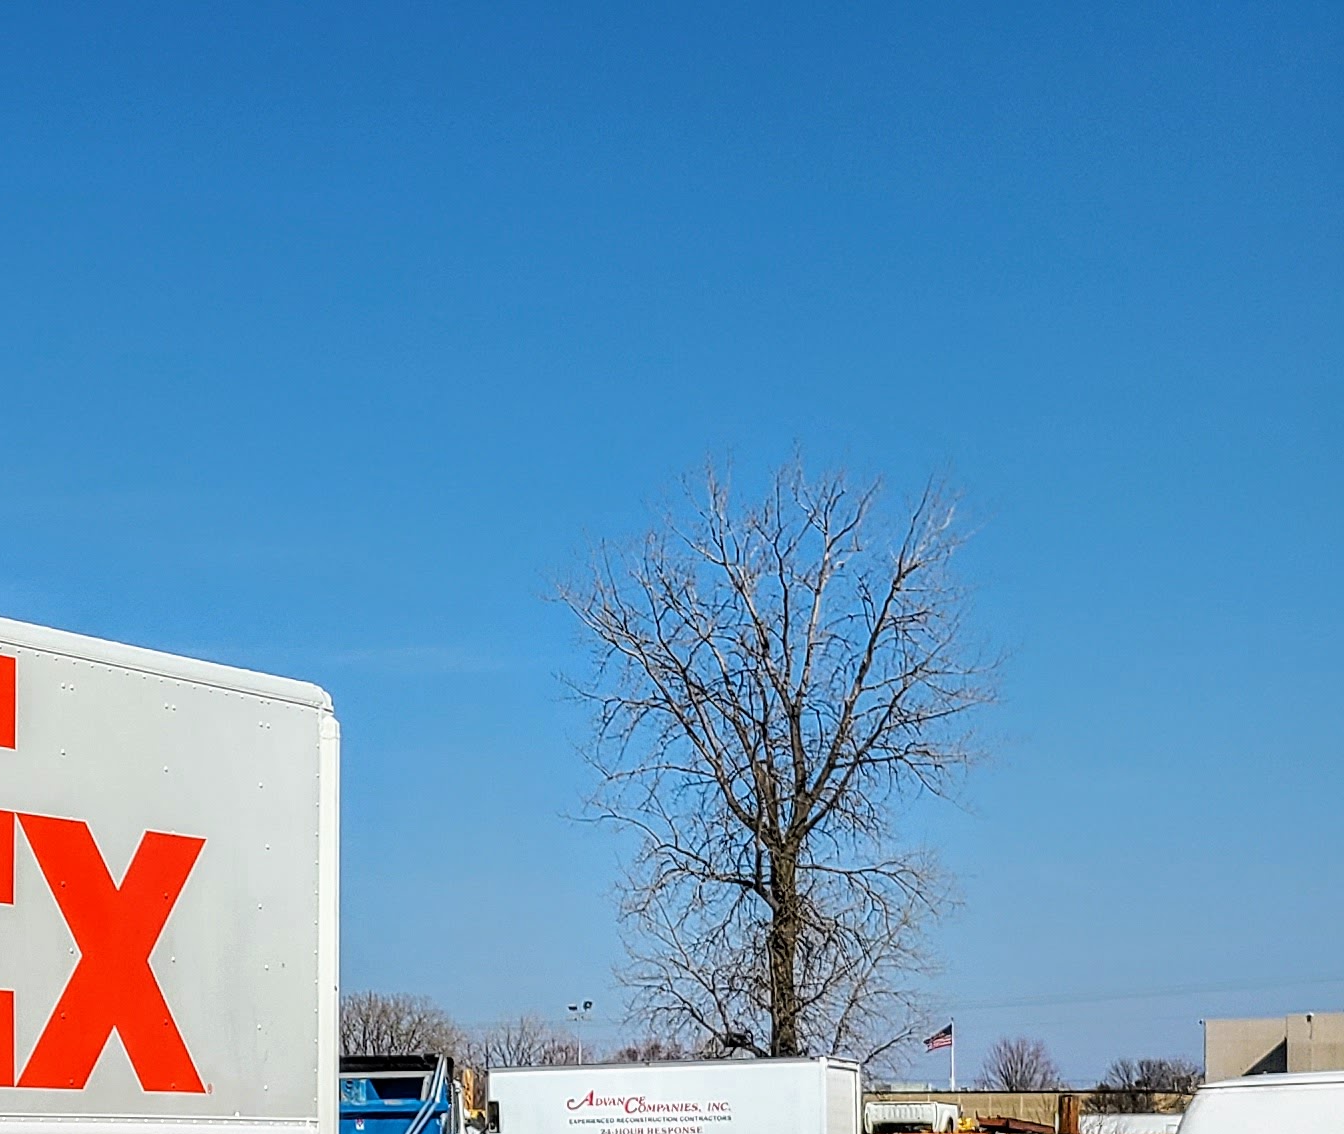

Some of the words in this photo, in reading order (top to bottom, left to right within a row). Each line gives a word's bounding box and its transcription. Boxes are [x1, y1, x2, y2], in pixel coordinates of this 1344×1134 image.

[707, 1102, 731, 1112] INC.
[616, 1116, 678, 1124] RECONSTRUCTION
[647, 1126, 703, 1134] RESPONSE
